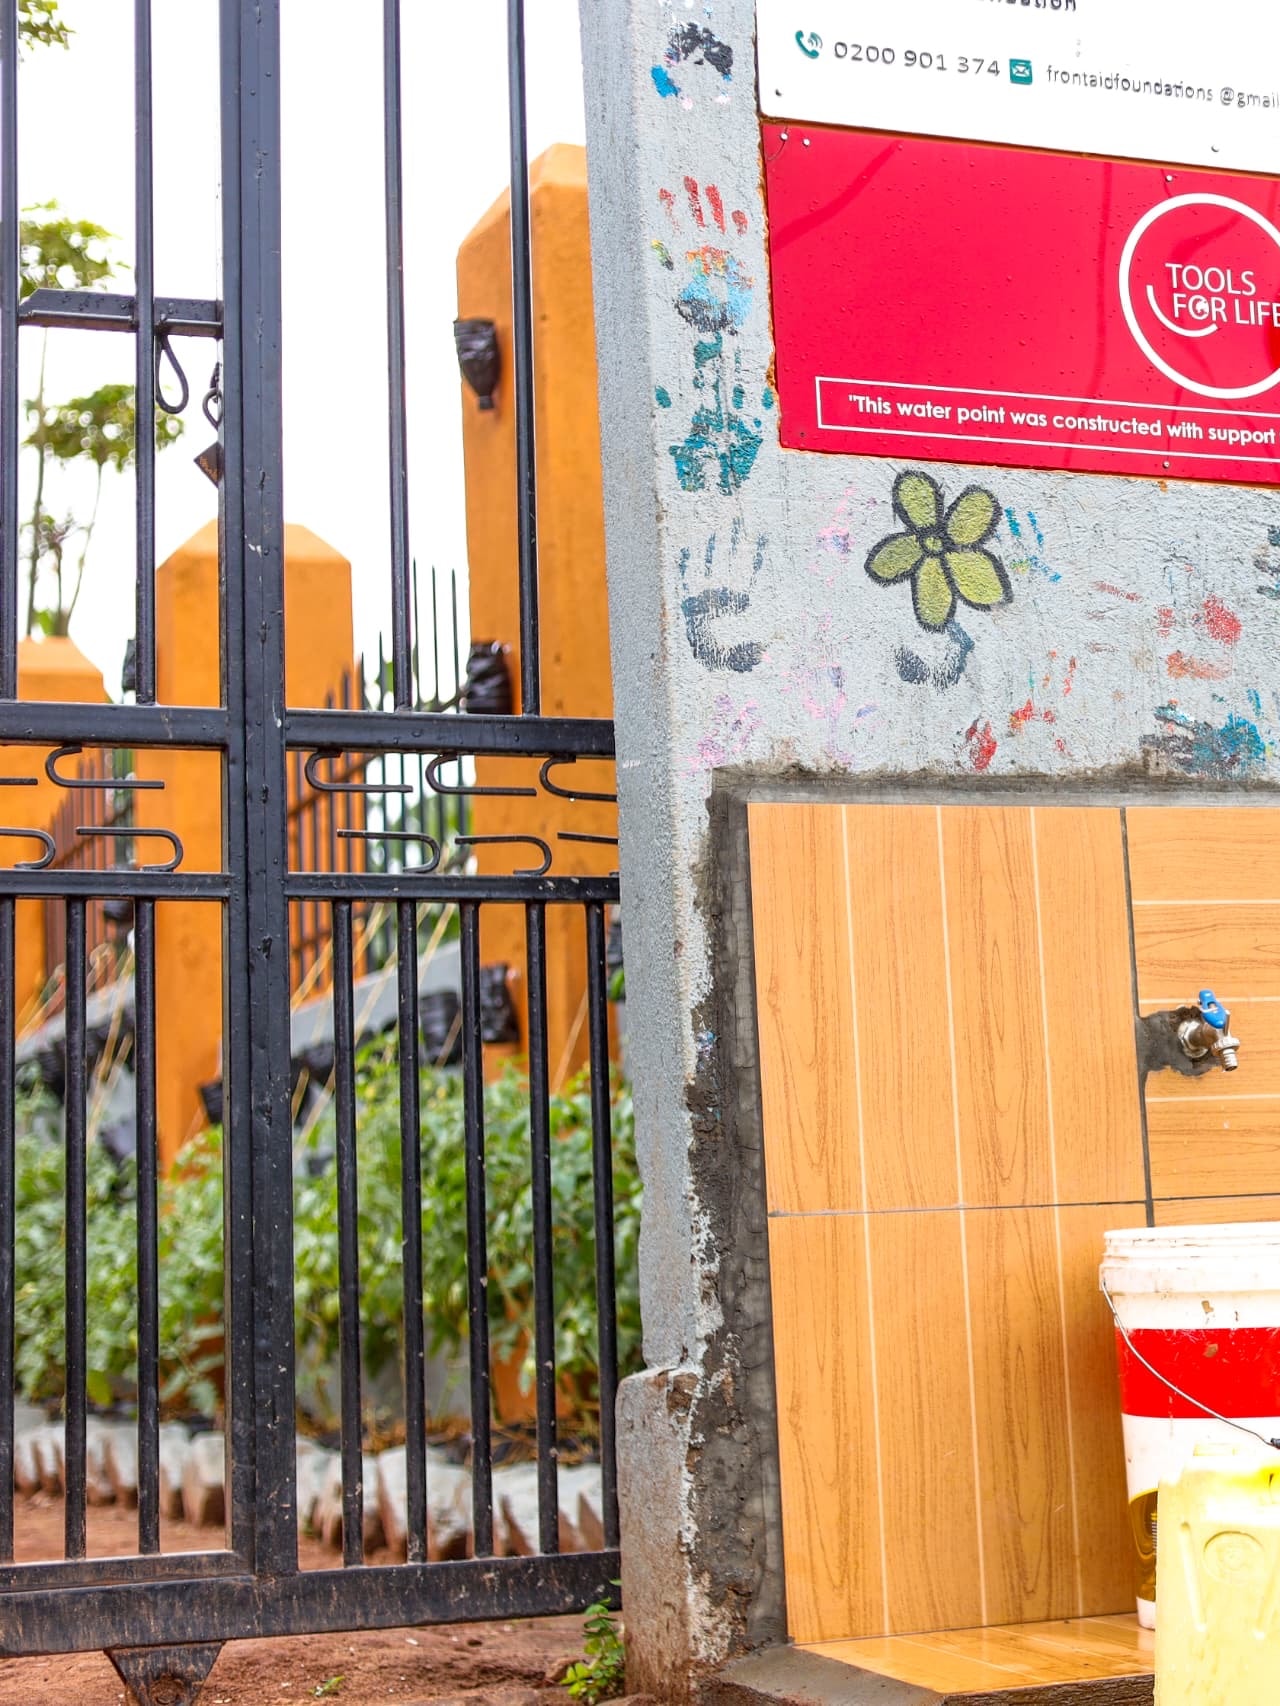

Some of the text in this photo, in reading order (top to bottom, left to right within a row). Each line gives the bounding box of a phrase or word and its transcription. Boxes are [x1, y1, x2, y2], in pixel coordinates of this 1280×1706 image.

[834, 42, 1001, 77] 0200 901 374
[1046, 65, 1214, 102] frontaidfoundations
[1165, 262, 1257, 296] TOOLS
[1173, 293, 1228, 323] FOR
[848, 394, 892, 415] "This
[896, 399, 952, 421] water
[957, 404, 1005, 425] point
[1010, 412, 1048, 428] was
[1052, 412, 1162, 437] constructed
[1166, 421, 1203, 440] with
[1208, 426, 1276, 446] support
